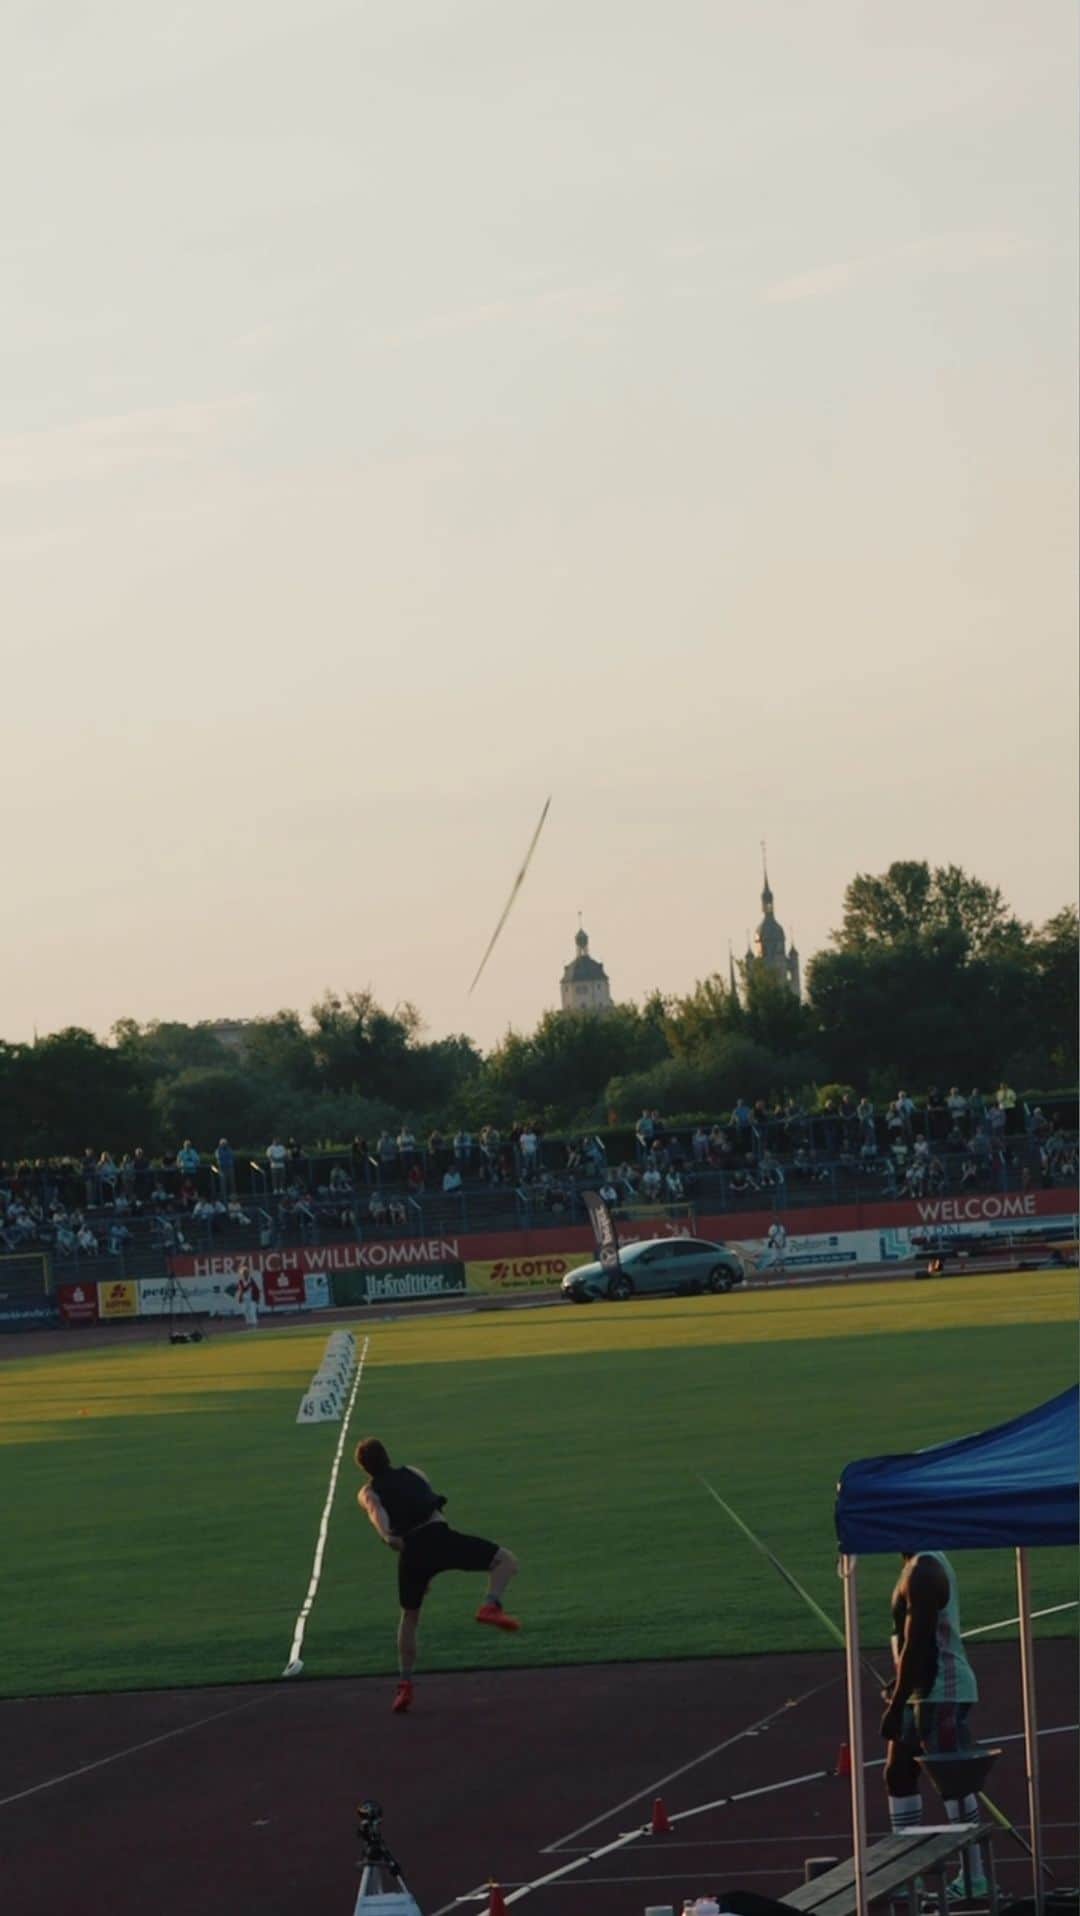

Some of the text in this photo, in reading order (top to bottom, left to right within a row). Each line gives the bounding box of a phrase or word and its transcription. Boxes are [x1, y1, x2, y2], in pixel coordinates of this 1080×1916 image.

[916, 1194, 1036, 1220] WELCOME
[193, 1239, 459, 1276] HERZLICH WILLKOMMEN
[512, 1259, 567, 1277] LOTTO
